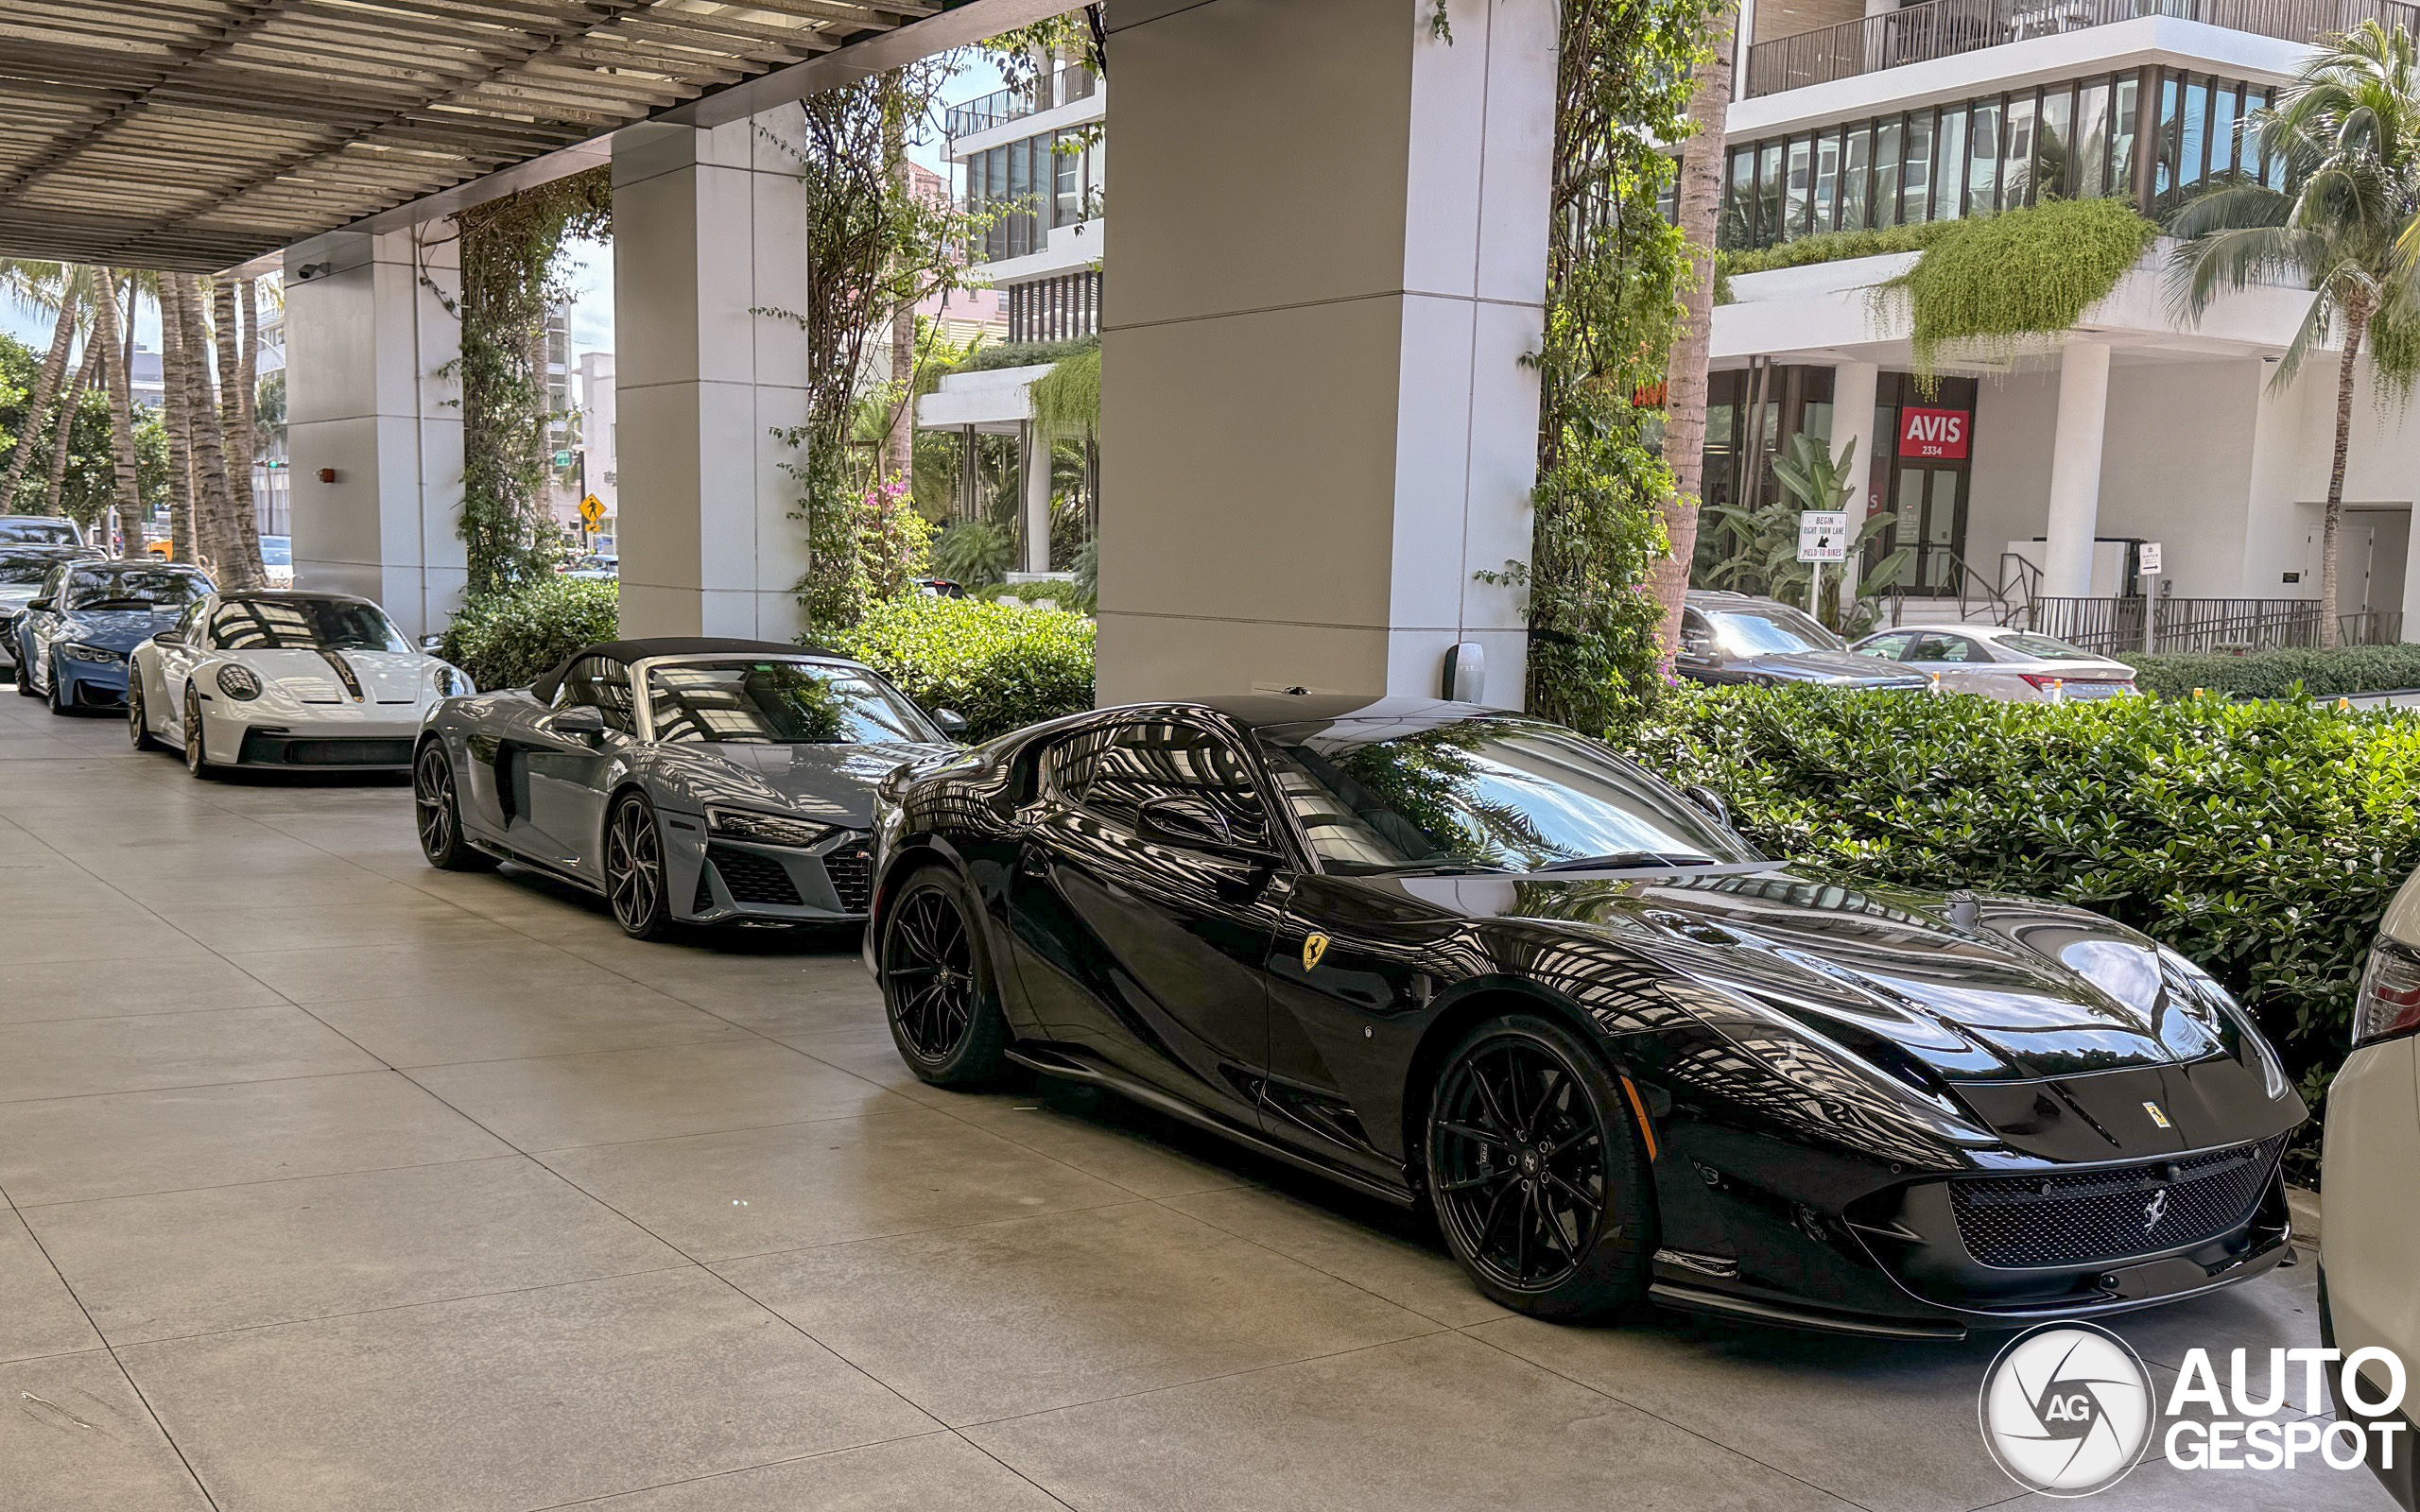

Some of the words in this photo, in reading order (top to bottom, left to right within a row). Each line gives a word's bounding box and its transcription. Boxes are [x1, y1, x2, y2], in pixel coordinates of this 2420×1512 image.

[1907, 415, 1962, 443] AVIS
[1922, 445, 1943, 455] 2334
[1816, 516, 1834, 524] BEGIN
[1803, 548, 1818, 557] YIELD
[1819, 548, 1826, 557] TO
